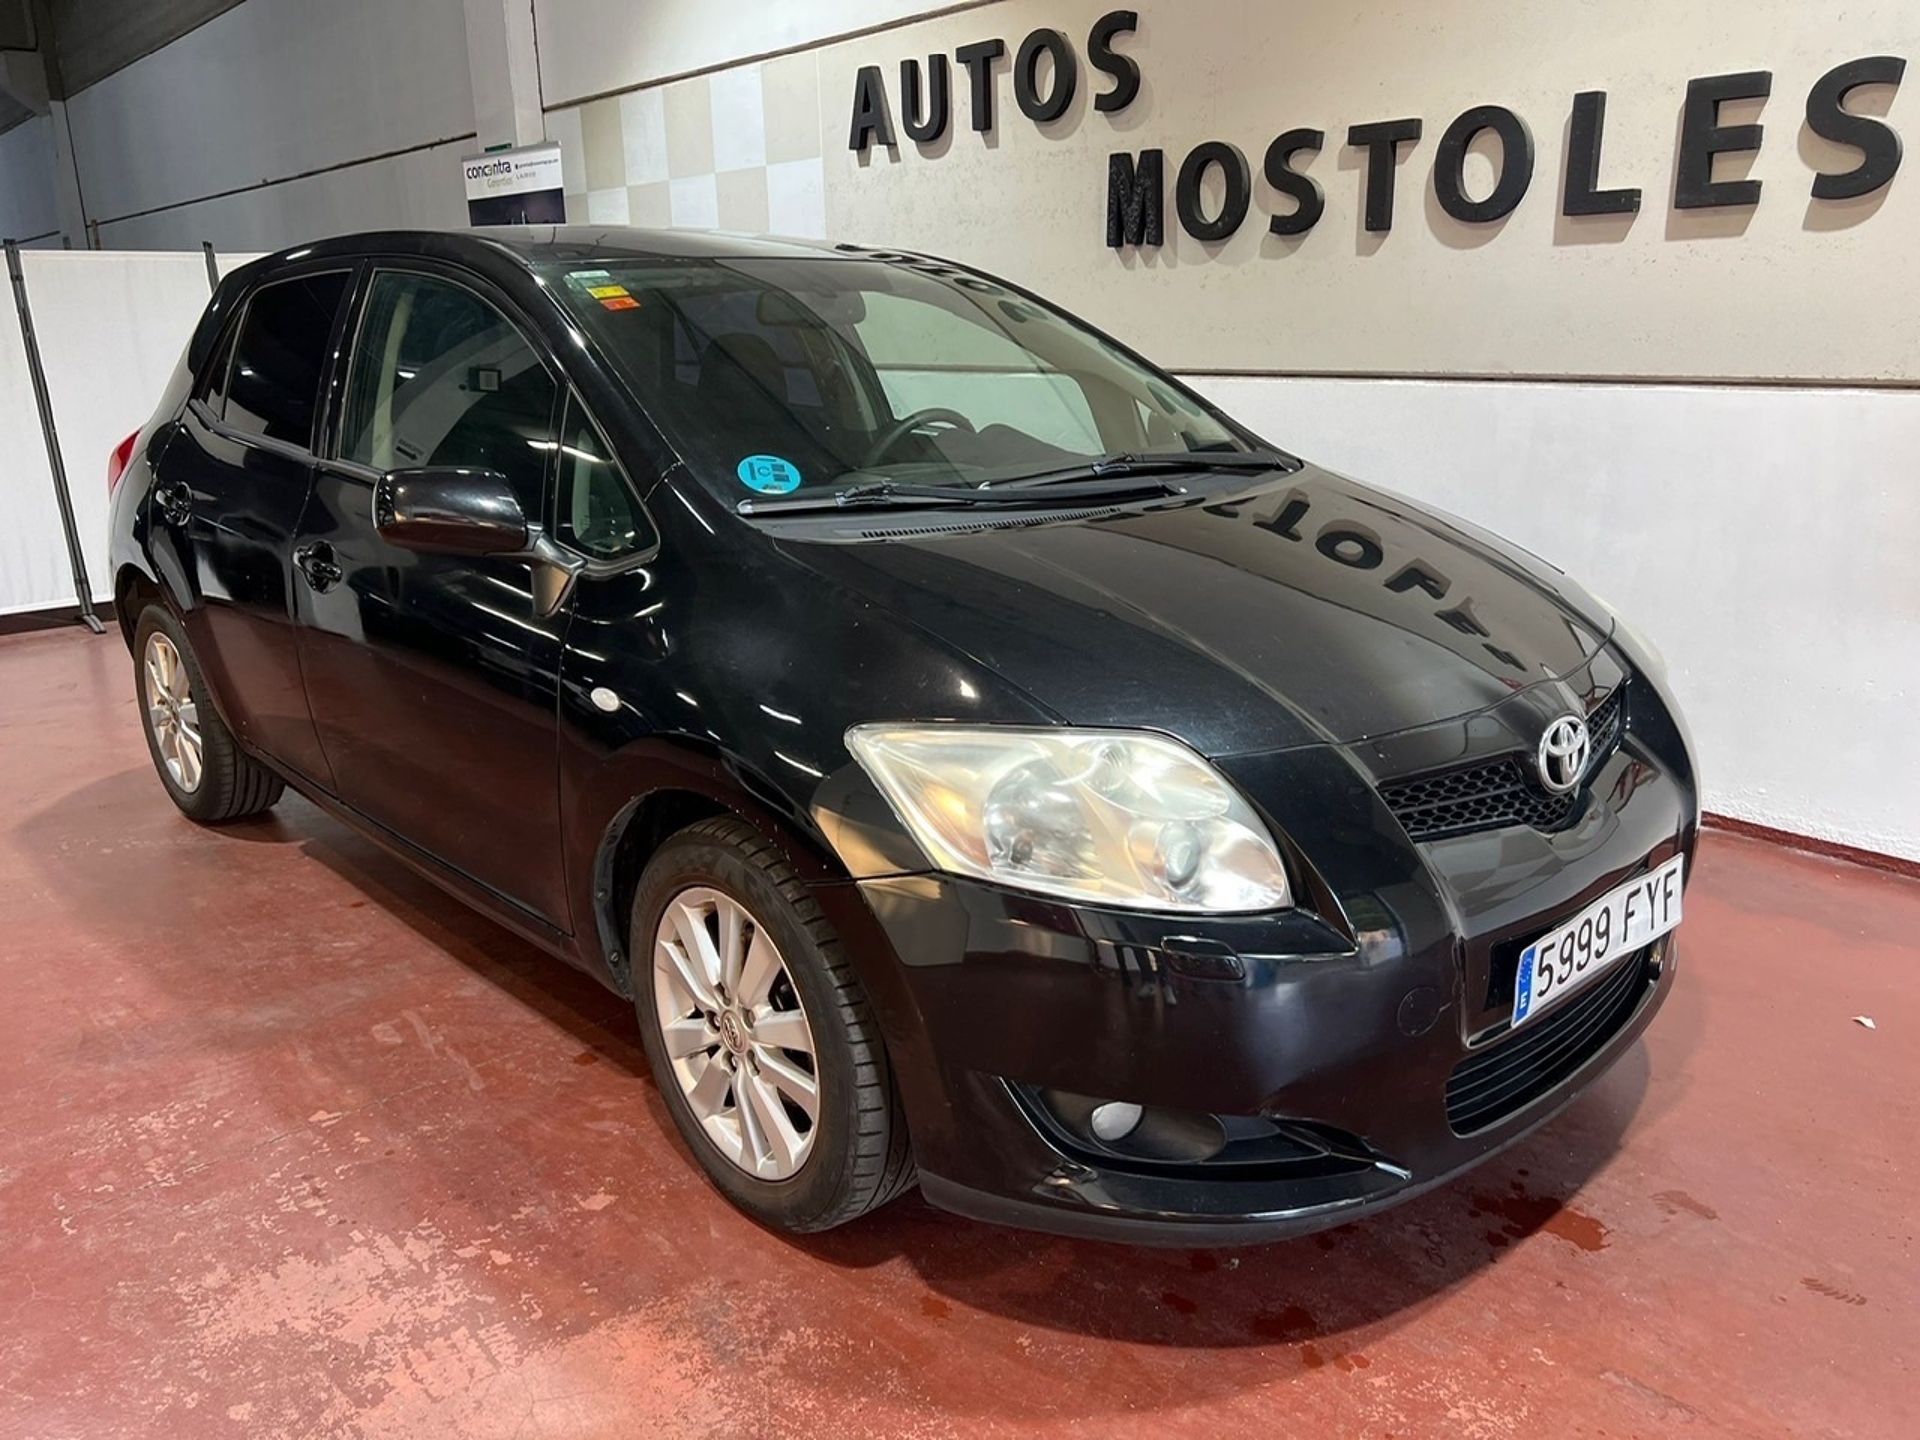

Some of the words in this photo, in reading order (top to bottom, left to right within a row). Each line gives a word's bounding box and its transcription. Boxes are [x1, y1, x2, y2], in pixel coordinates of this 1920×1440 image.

[849, 10, 1141, 151] AUTOS
[1106, 55, 1907, 248] MOSTOLES
[1519, 991, 1528, 1010] E
[1536, 905, 1611, 998] 5999
[1622, 867, 1677, 943] FYF
